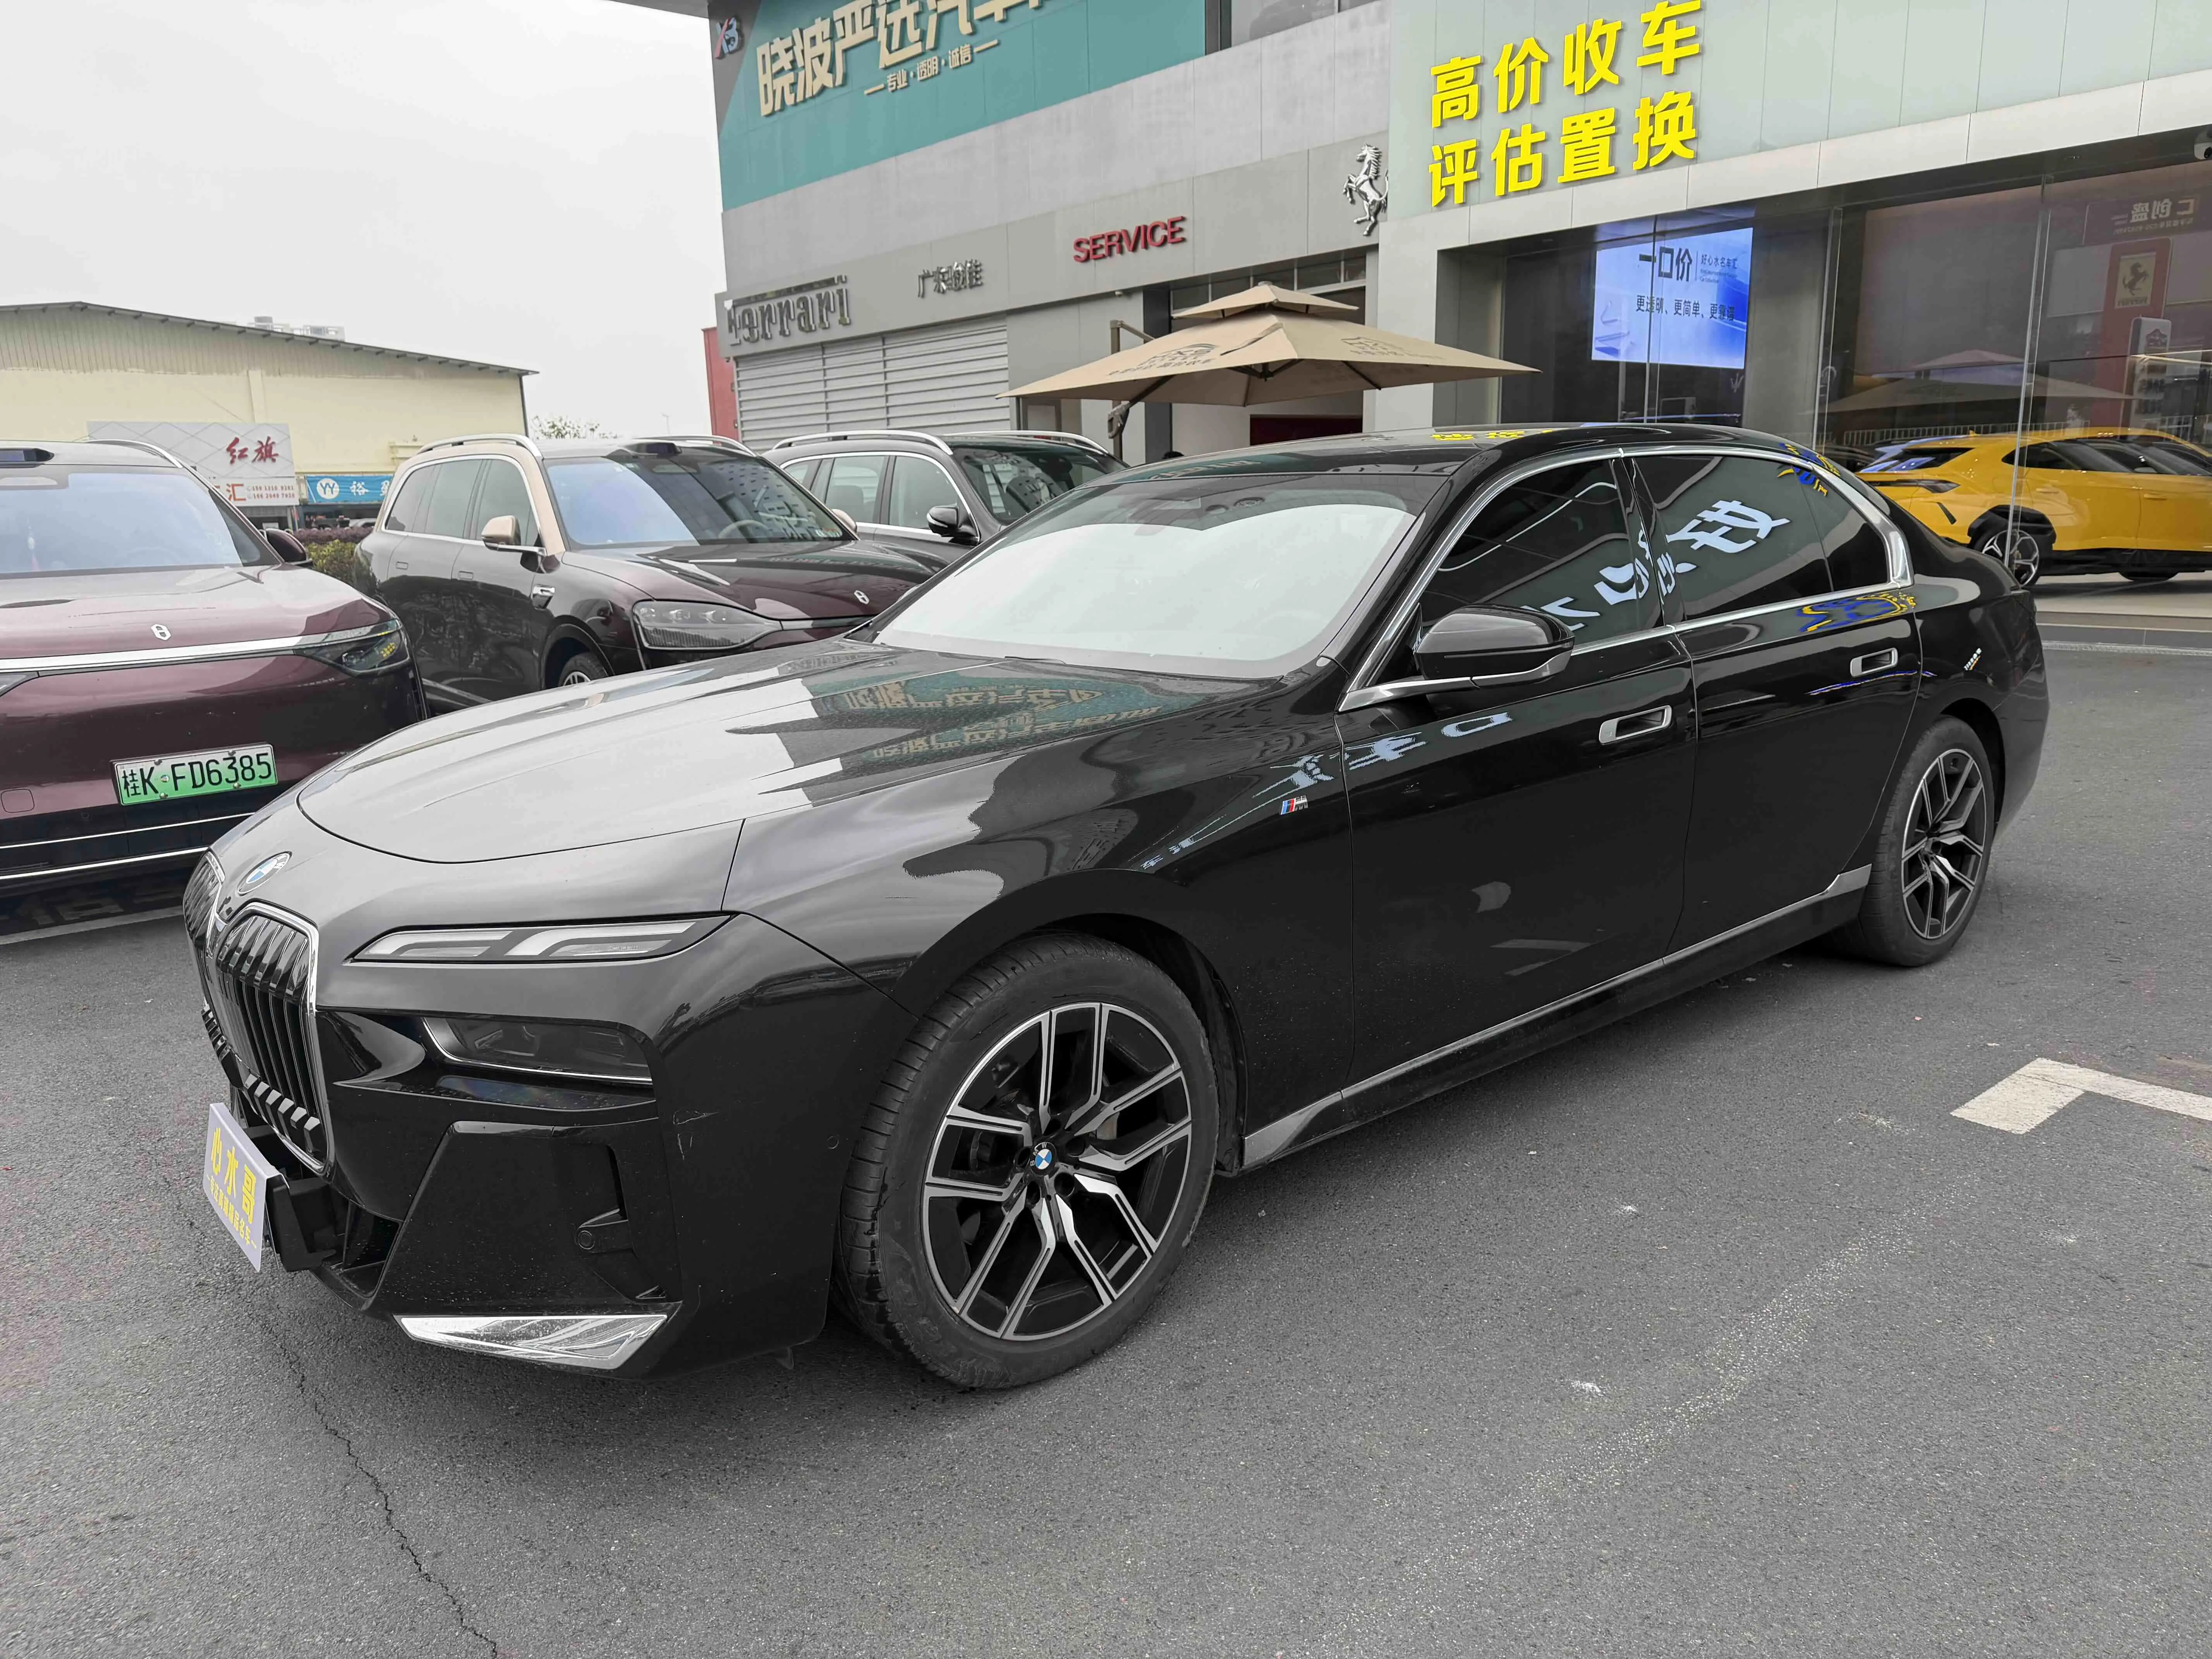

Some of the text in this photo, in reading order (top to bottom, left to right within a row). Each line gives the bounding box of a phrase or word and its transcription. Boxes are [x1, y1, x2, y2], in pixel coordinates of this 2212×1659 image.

[1430, 0, 1702, 128] 高价收车
[1428, 90, 1697, 208] 评估置换
[1073, 215, 1188, 263] SERVICE
[1639, 246, 1693, 282] 一口价
[724, 274, 851, 346] Ferrari
[226, 436, 279, 465] 红旗
[211, 1127, 257, 1224] 心水哥
